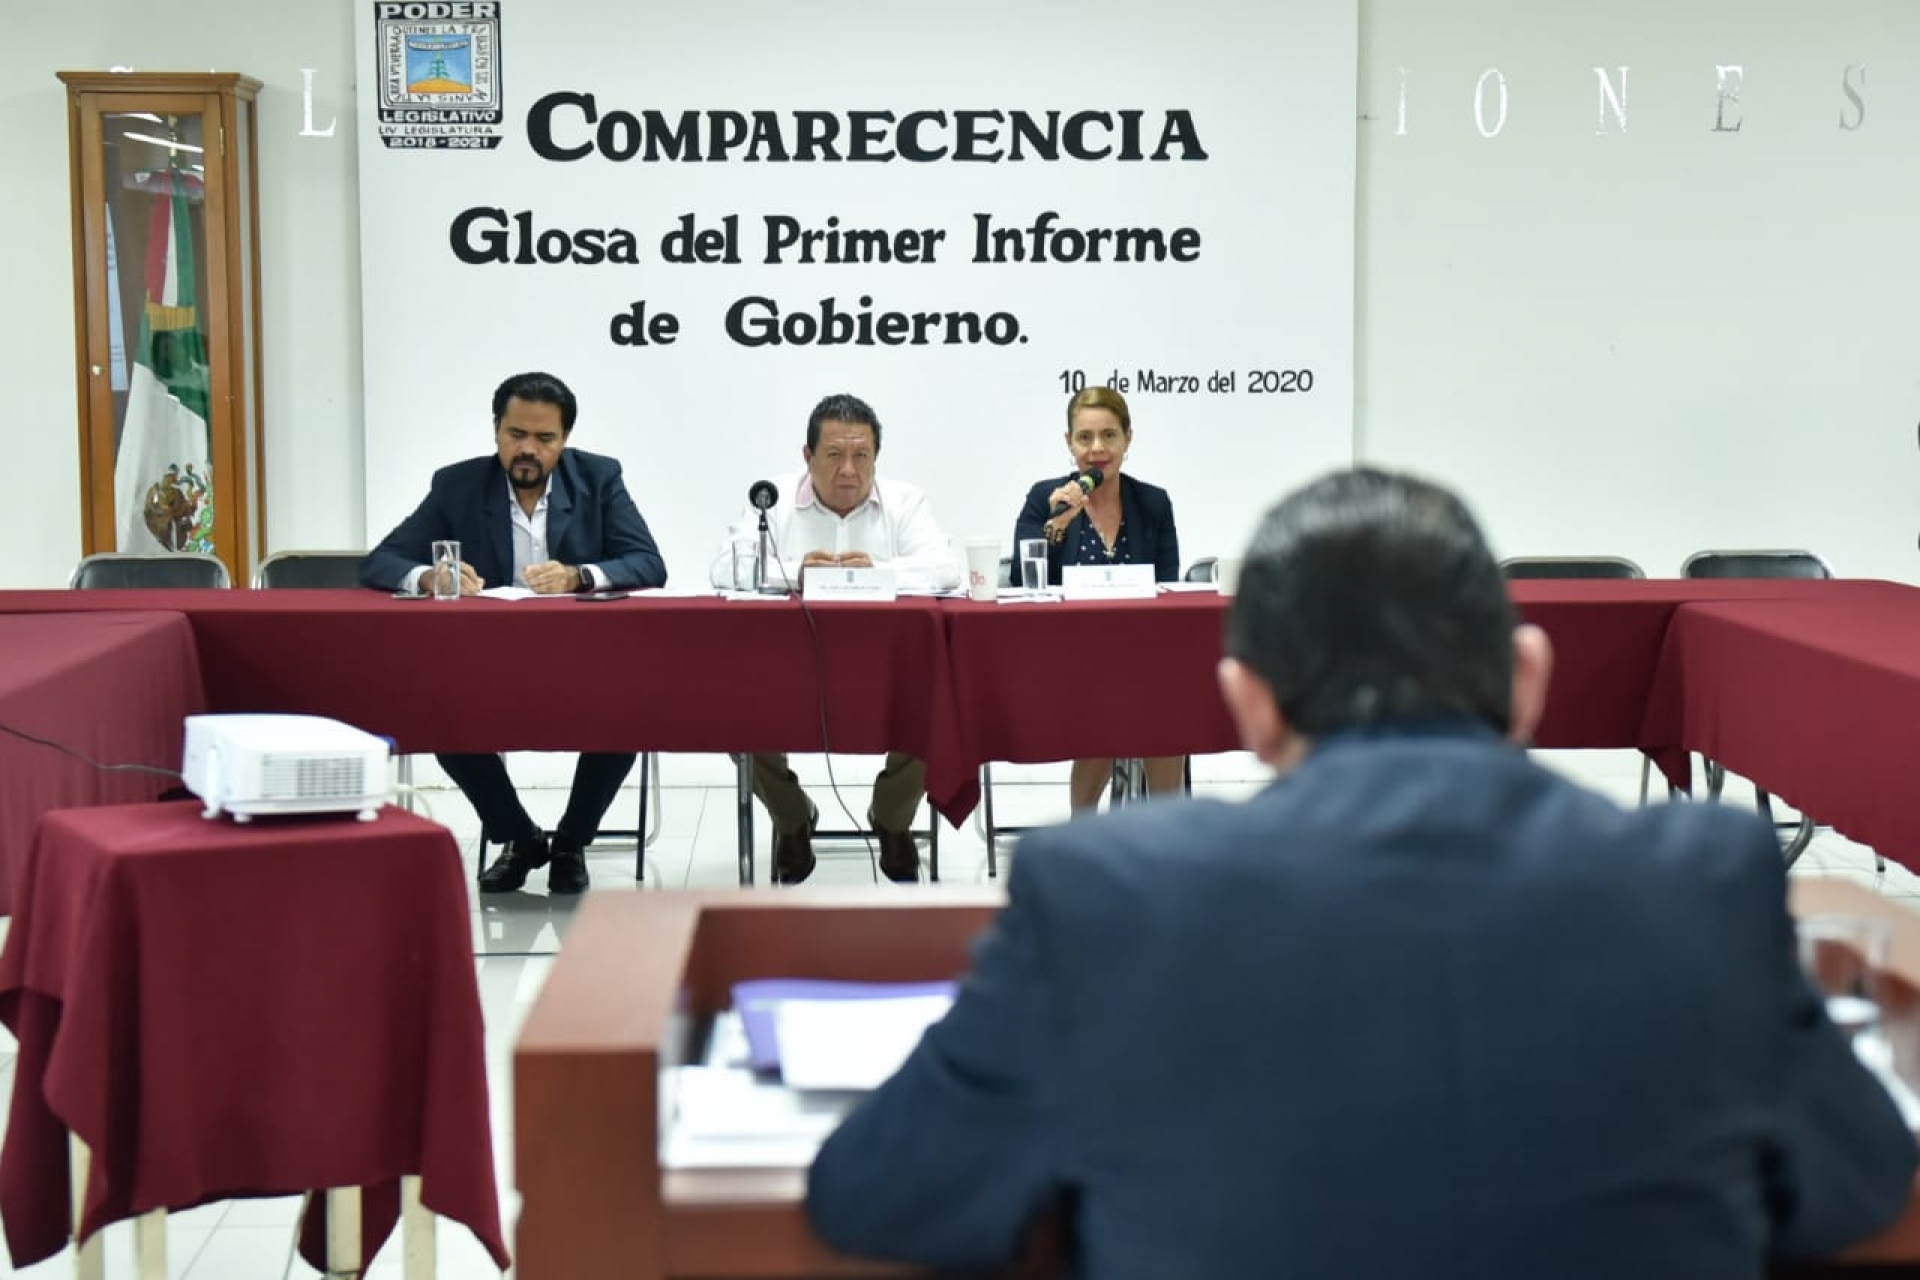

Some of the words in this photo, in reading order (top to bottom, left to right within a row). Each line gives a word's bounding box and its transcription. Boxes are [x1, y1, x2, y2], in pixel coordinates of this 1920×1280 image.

[379, 2, 496, 19] PODER
[383, 110, 496, 123] LEGISLATIVO
[527, 92, 1208, 162] COMPARECENCIA
[379, 125, 398, 134] LIV
[404, 125, 493, 134] LEGISLATURA
[389, 136, 488, 148] 2018-2021
[450, 207, 639, 264] Glosa
[661, 213, 741, 264] del
[764, 216, 945, 264] Primer
[972, 212, 1200, 262] Informe
[610, 300, 680, 346] de
[725, 296, 1029, 347] Gobierno.
[1059, 370, 1086, 394] 10
[1107, 369, 1130, 393] de
[1137, 370, 1200, 393] Marzo
[1207, 371, 1236, 393] del
[1247, 370, 1314, 393] 2020
